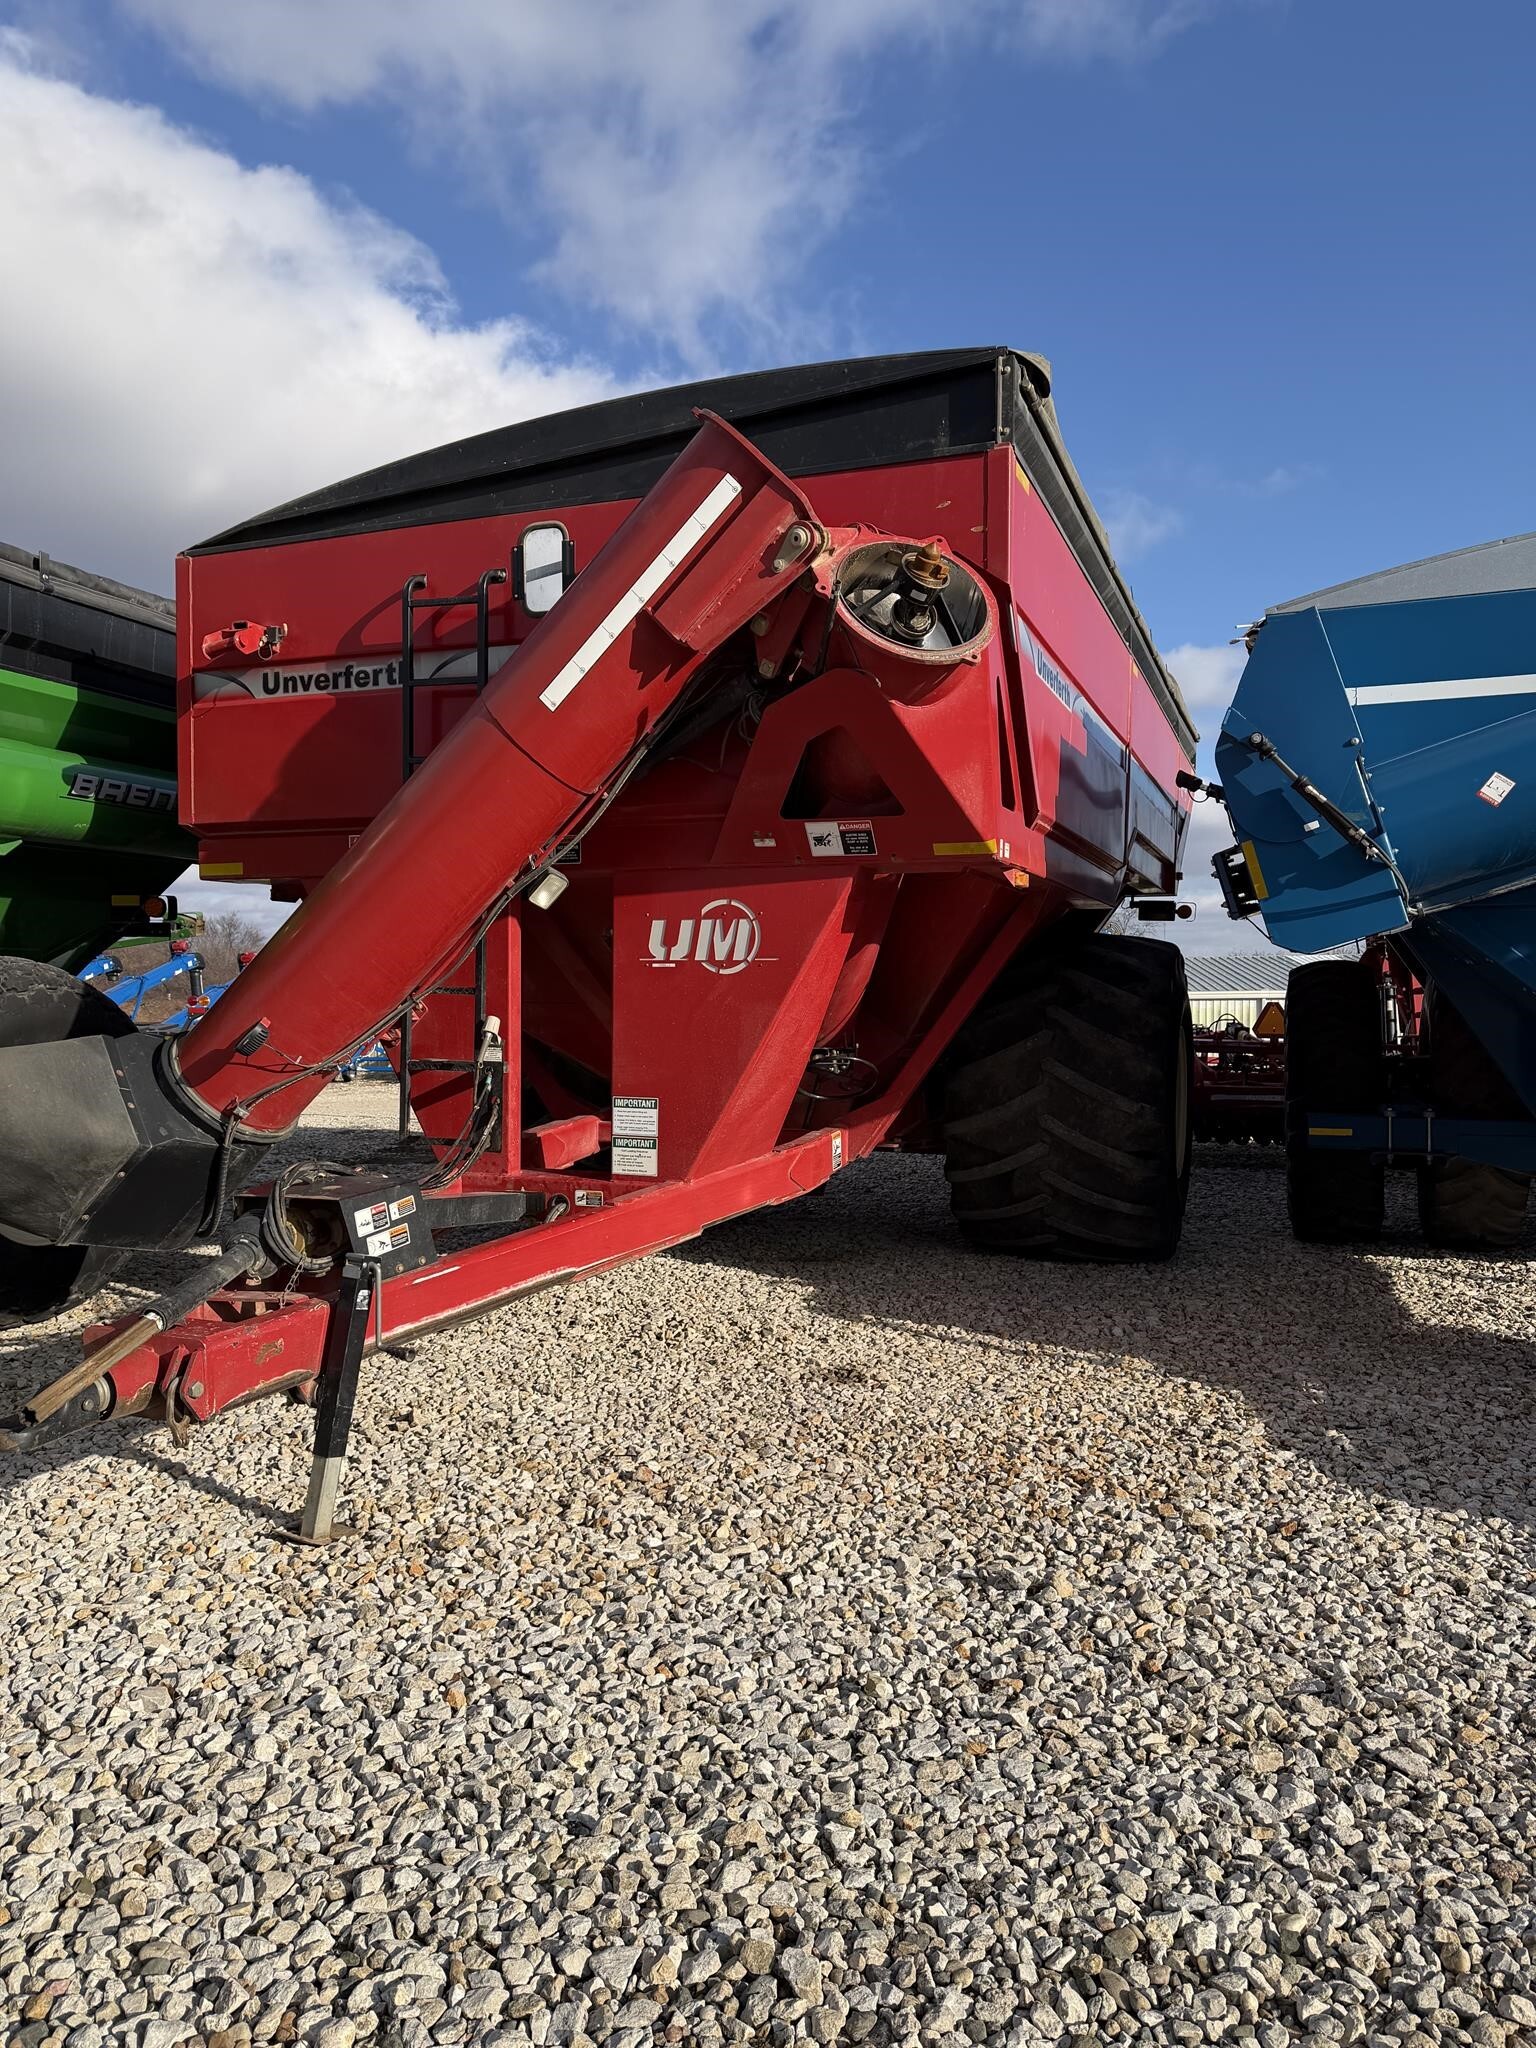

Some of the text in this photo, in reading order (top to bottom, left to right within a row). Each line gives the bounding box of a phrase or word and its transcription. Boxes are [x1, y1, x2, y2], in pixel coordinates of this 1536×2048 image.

[1037, 647, 1071, 709] Unverferth
[72, 773, 177, 812] BREN
[615, 1098, 656, 1108] IMPORTANT
[615, 1138, 654, 1148] IMPORTANT
